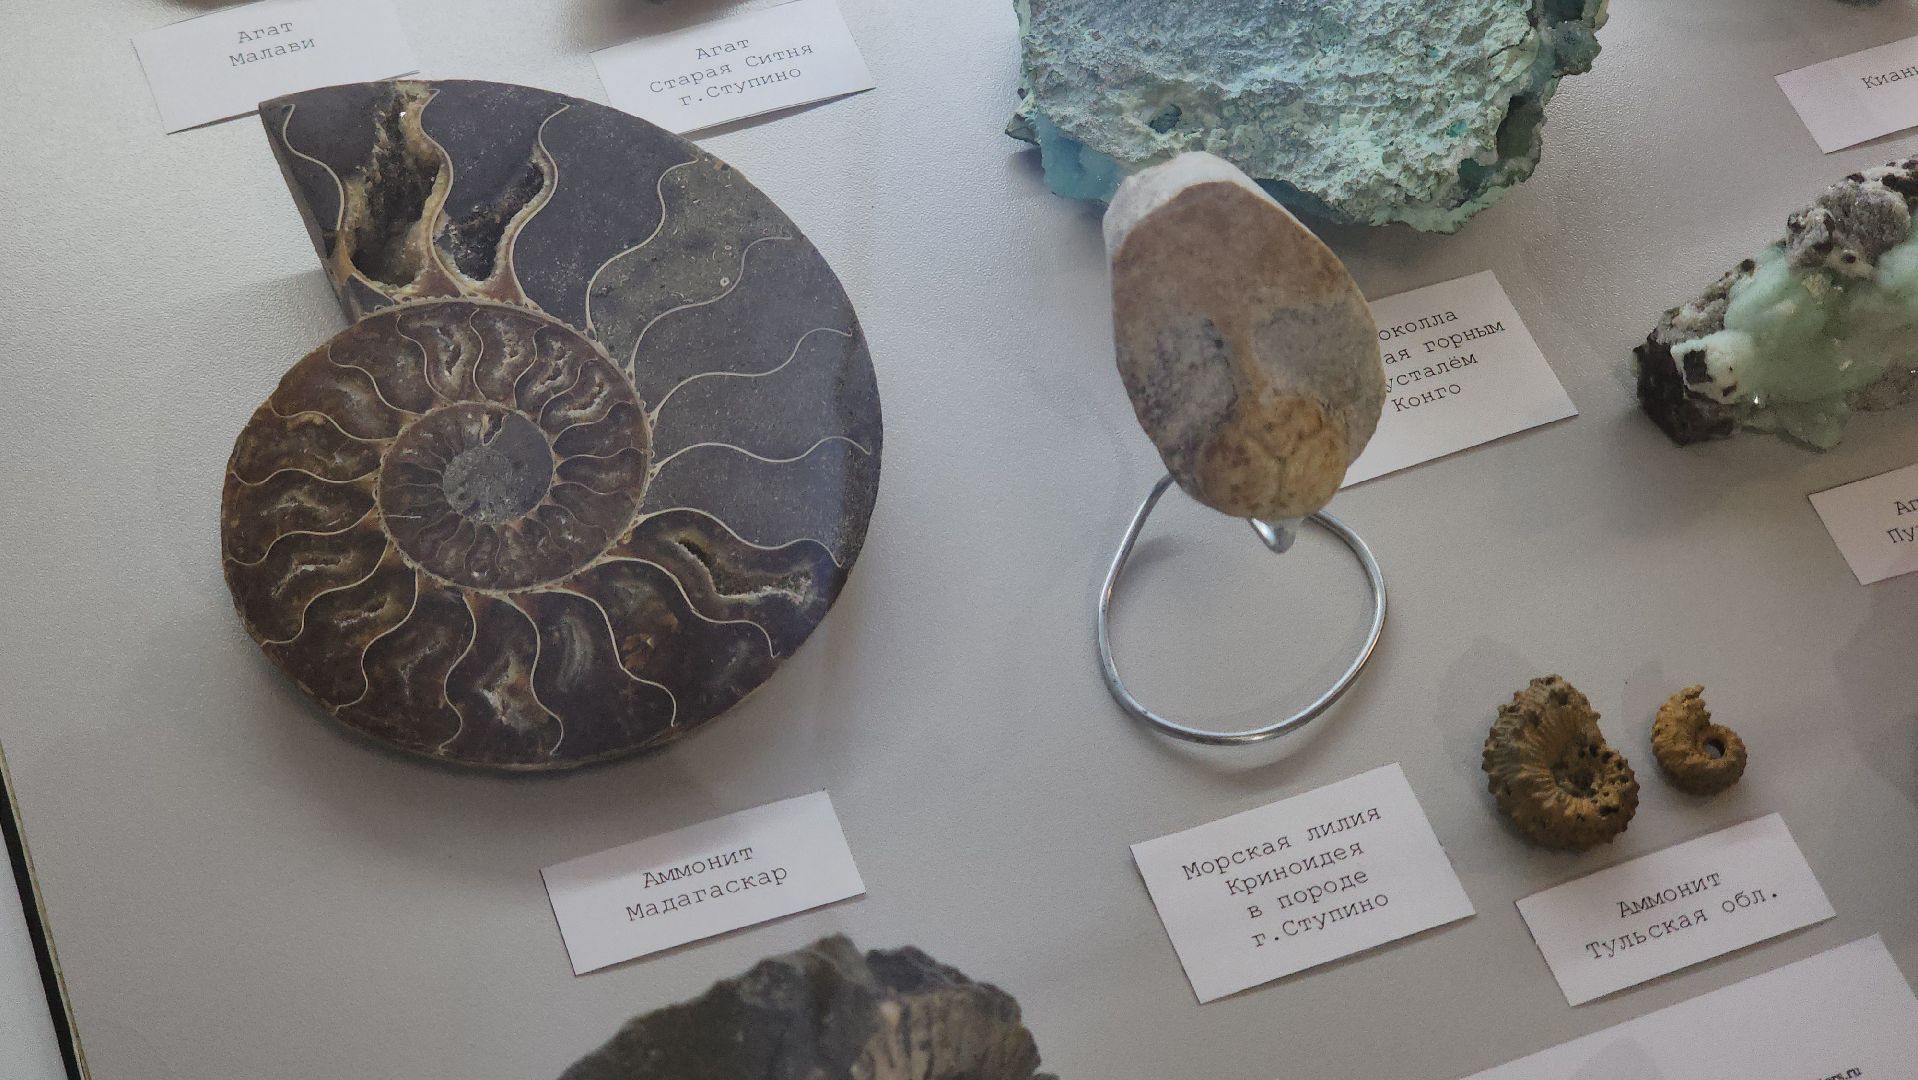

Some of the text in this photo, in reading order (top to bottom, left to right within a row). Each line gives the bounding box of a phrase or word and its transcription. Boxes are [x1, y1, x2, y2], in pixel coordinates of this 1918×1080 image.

[229, 38, 315, 67] Малави
[237, 22, 293, 44] Агат
[696, 39, 750, 60] Агат
[649, 44, 814, 93] Старая Ситня
[679, 68, 802, 106] г.Ступино
[1378, 311, 1459, 341] околла
[1383, 321, 1506, 364] ая горным
[1385, 353, 1479, 393] усталём
[1391, 383, 1461, 412] Конго
[1894, 498, 1918, 516] Аг
[1886, 525, 1918, 543] Пу
[1182, 806, 1382, 881] Морская лилия
[642, 847, 753, 888] Аммонит
[1224, 842, 1364, 896] Криноидея
[625, 866, 788, 922] Мадагаскар
[1247, 869, 1369, 919] в породе
[1616, 872, 1721, 918] Аммонит
[1250, 892, 1389, 948] г.Ступино
[1585, 887, 1778, 960] Тульская обл.
